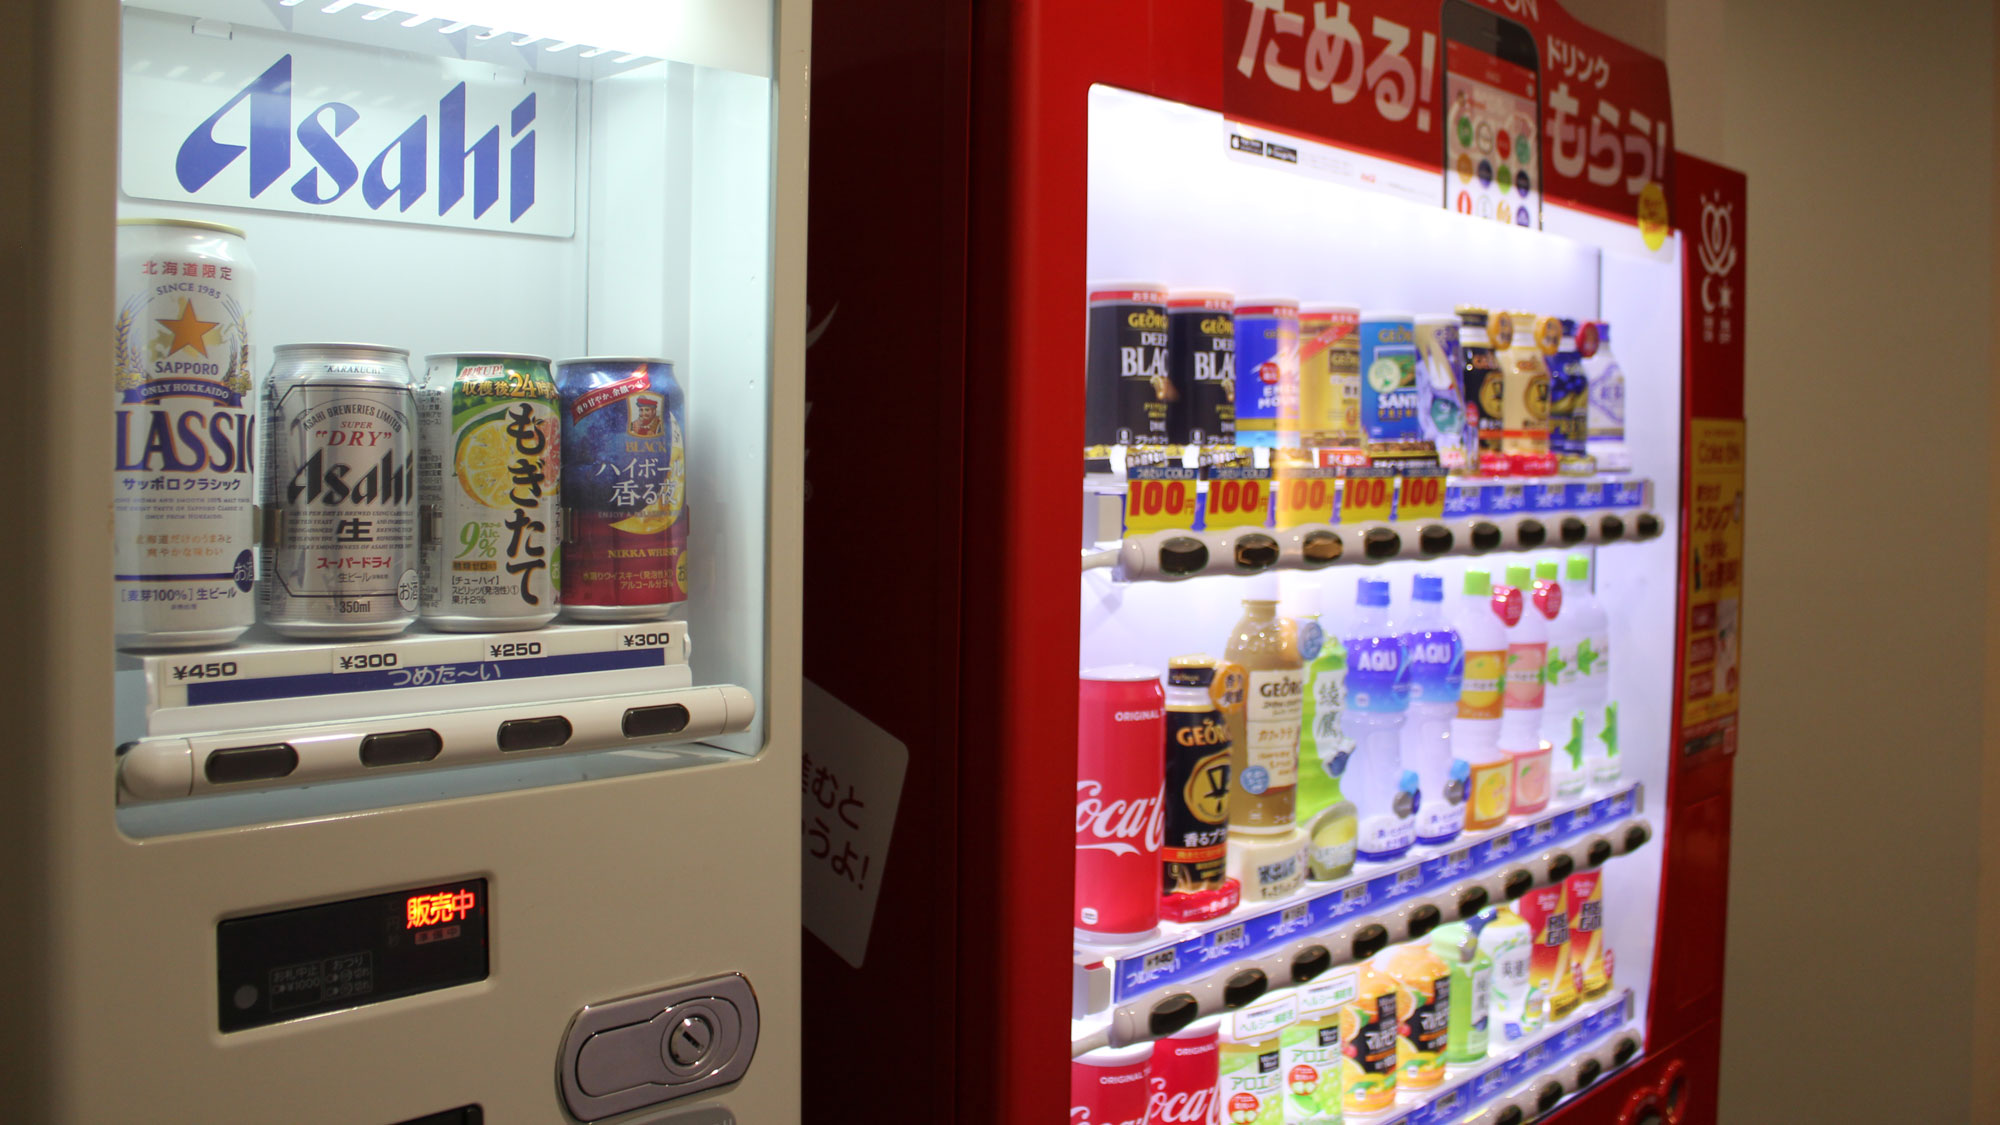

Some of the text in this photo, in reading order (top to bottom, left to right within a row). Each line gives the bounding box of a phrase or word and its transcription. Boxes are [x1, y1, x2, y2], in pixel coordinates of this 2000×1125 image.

[1237, 0, 1436, 132] ためる!
[1546, 34, 1610, 89] ドリンク
[175, 53, 536, 223] Asahi
[142, 261, 233, 281] 北海道限定
[155, 282, 194, 296] SINCE
[155, 360, 219, 376] SAPPORO
[140, 383, 229, 399] ONLY HOKKAIDO
[302, 403, 403, 433] ASAHI BREWERIES LIMITED
[340, 421, 373, 429] SUPER
[122, 476, 241, 491] サッポロクラシック
[286, 448, 414, 506] Asahi
[505, 402, 547, 606] もぎたて
[335, 517, 374, 542] 生
[608, 549, 646, 559] NIKKA
[316, 557, 392, 569] スーパードライ
[339, 600, 371, 613] 350ml
[623, 632, 670, 648] ¥300
[490, 642, 542, 658] ¥250
[340, 653, 398, 670] ¥300
[173, 661, 237, 681] ¥450
[1114, 710, 1159, 723] ORIGINAL
[802, 816, 870, 892] うよ!
[406, 888, 475, 929] 販売中
